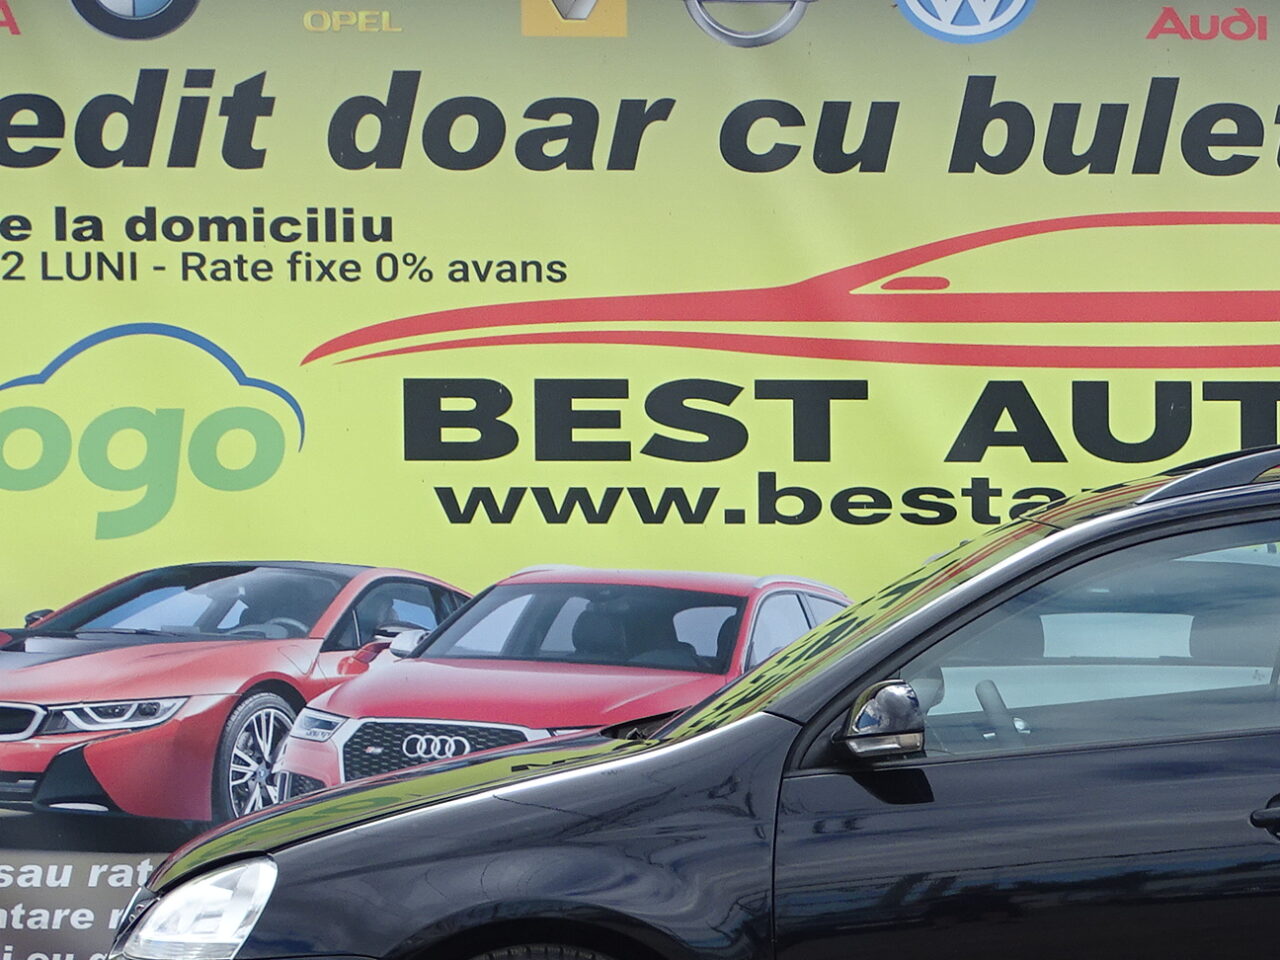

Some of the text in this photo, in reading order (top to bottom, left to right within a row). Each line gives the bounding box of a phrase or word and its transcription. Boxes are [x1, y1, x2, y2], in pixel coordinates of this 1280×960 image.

[303, 9, 402, 32] OPEL
[1145, 6, 1268, 40] Audi
[0, 69, 275, 169] edit
[328, 70, 676, 171] doar
[720, 100, 900, 174] cu
[55, 207, 104, 242] la
[125, 207, 392, 242] domiciliu
[2, 251, 25, 281] 2
[42, 252, 136, 281] LUNI
[182, 252, 273, 281] Rate
[287, 251, 361, 282] fixe
[376, 252, 433, 282] 0%
[448, 260, 567, 283] avans
[403, 378, 868, 462] BEST
[434, 472, 1100, 524] www.besta
[0, 865, 73, 887] sau
